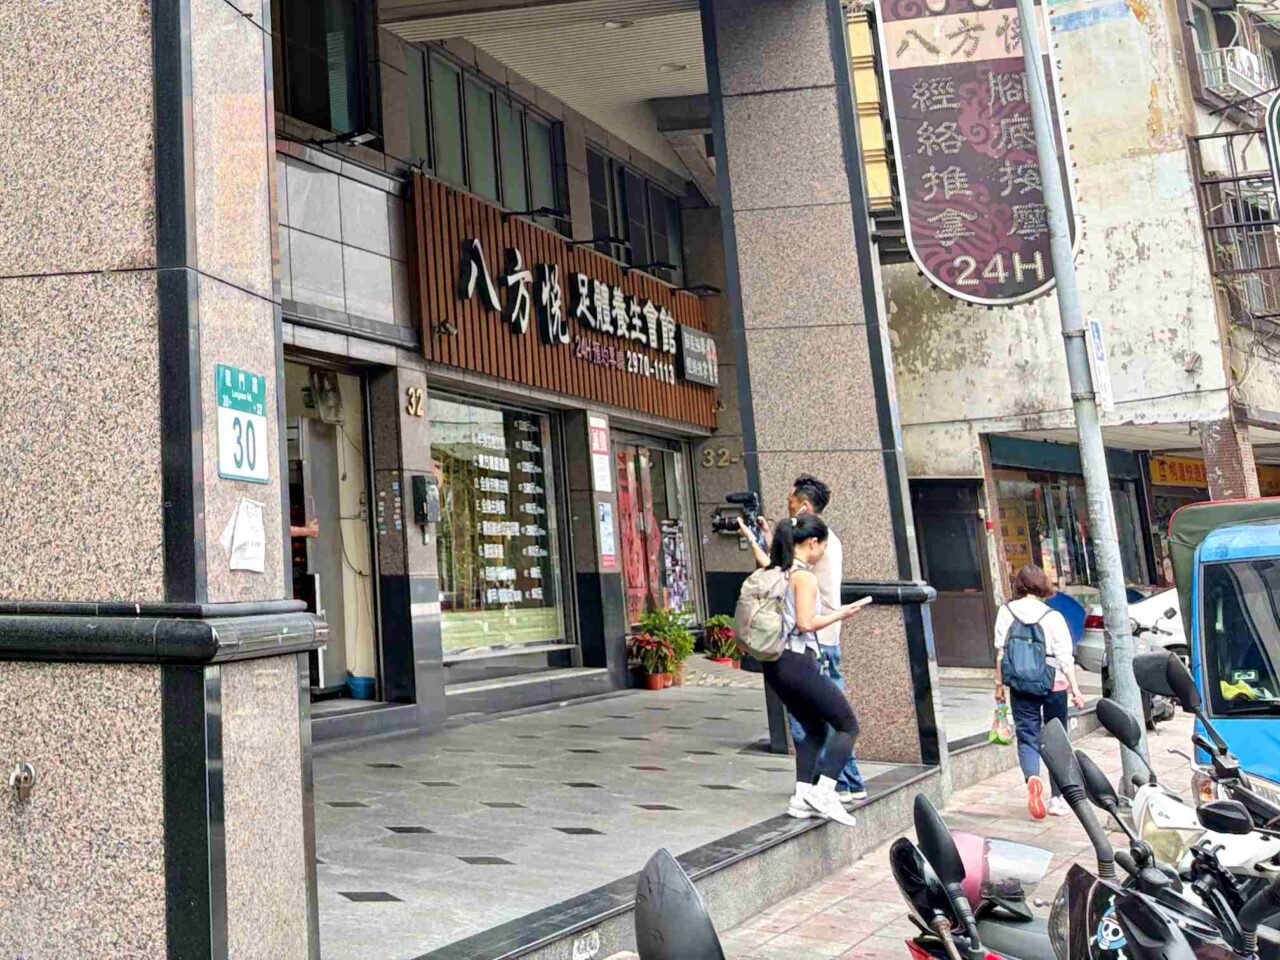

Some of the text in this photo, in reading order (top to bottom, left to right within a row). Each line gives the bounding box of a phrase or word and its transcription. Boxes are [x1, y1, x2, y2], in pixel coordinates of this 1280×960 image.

[912, 76, 978, 247] 經絡推拿
[468, 238, 570, 344] 八方悅
[952, 250, 1045, 286] 24H
[576, 273, 677, 355] 足體養生會館
[627, 350, 675, 386] 2970-1113
[408, 386, 424, 416] 32
[232, 416, 256, 471] 30
